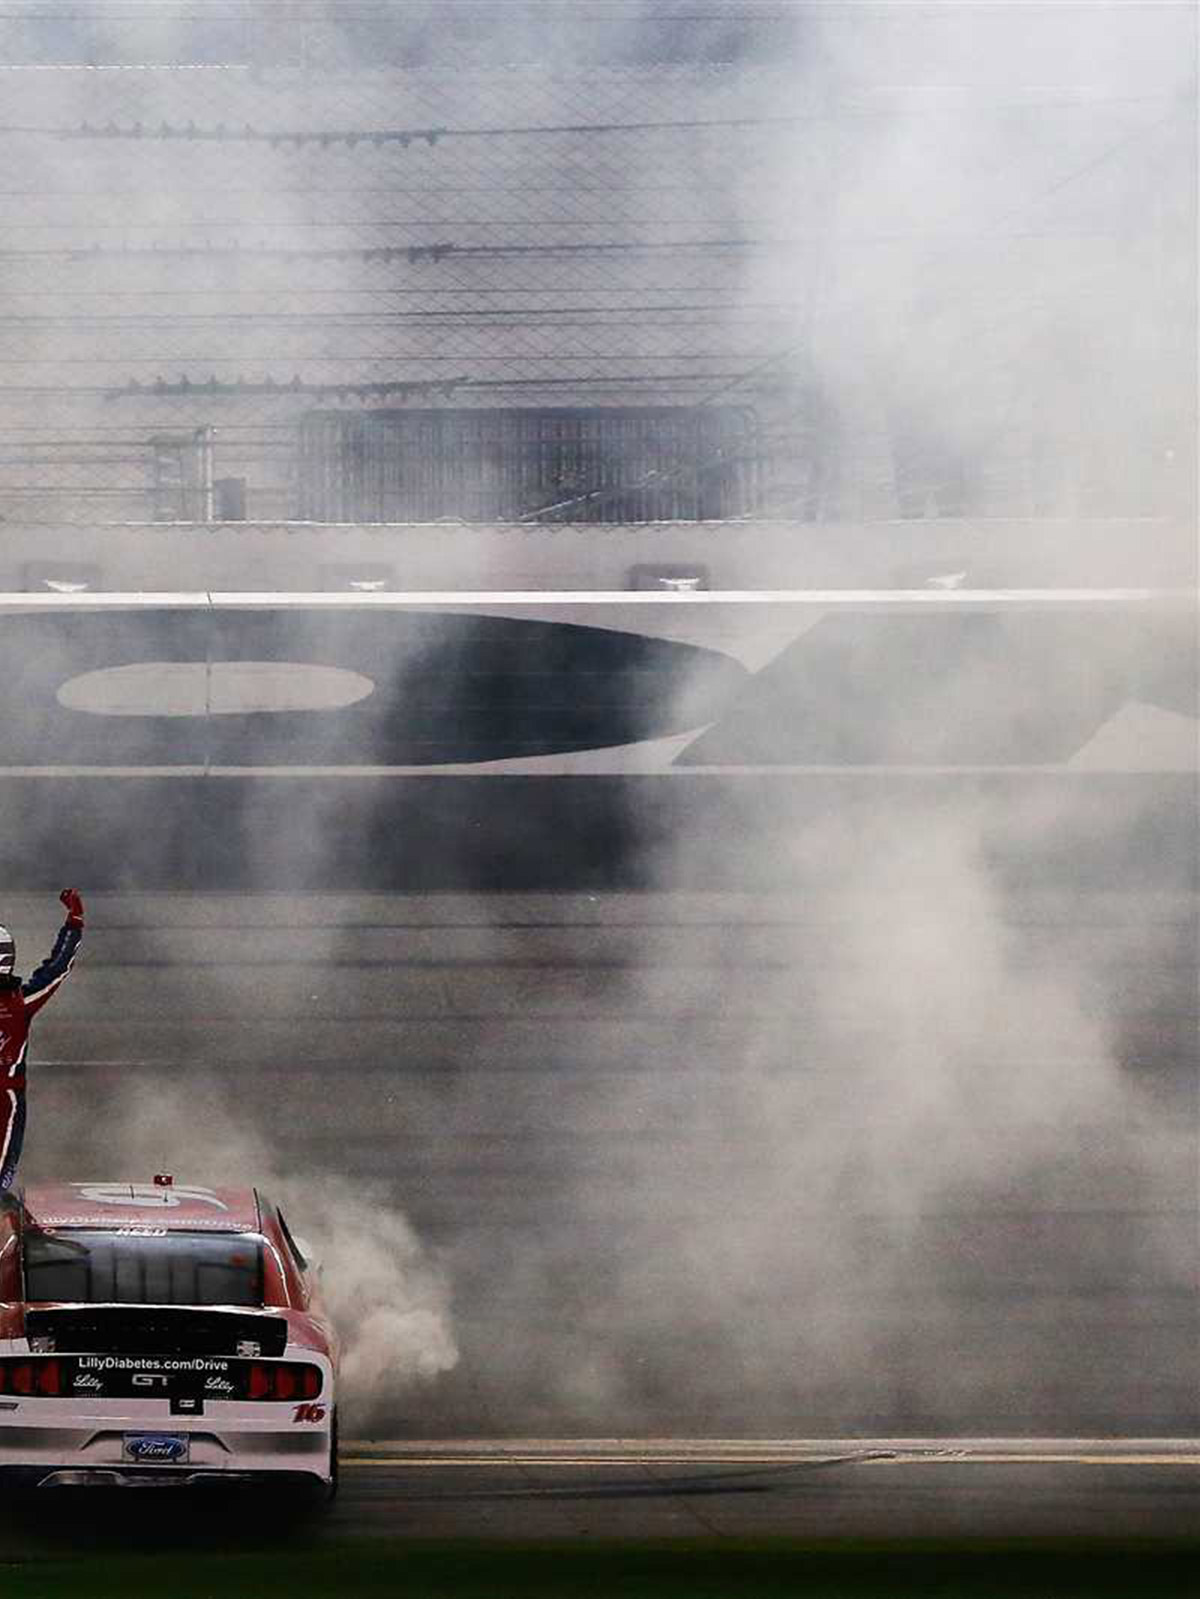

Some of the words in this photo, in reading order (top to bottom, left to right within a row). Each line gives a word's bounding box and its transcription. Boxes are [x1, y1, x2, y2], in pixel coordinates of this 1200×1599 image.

[78, 1357, 229, 1370] LillyDiabetes.com/Drive
[73, 1374, 103, 1390] Lilly
[132, 1374, 175, 1386] GT
[204, 1376, 234, 1393] Lilly
[293, 1403, 326, 1423] 16
[138, 1440, 173, 1455] Ford
